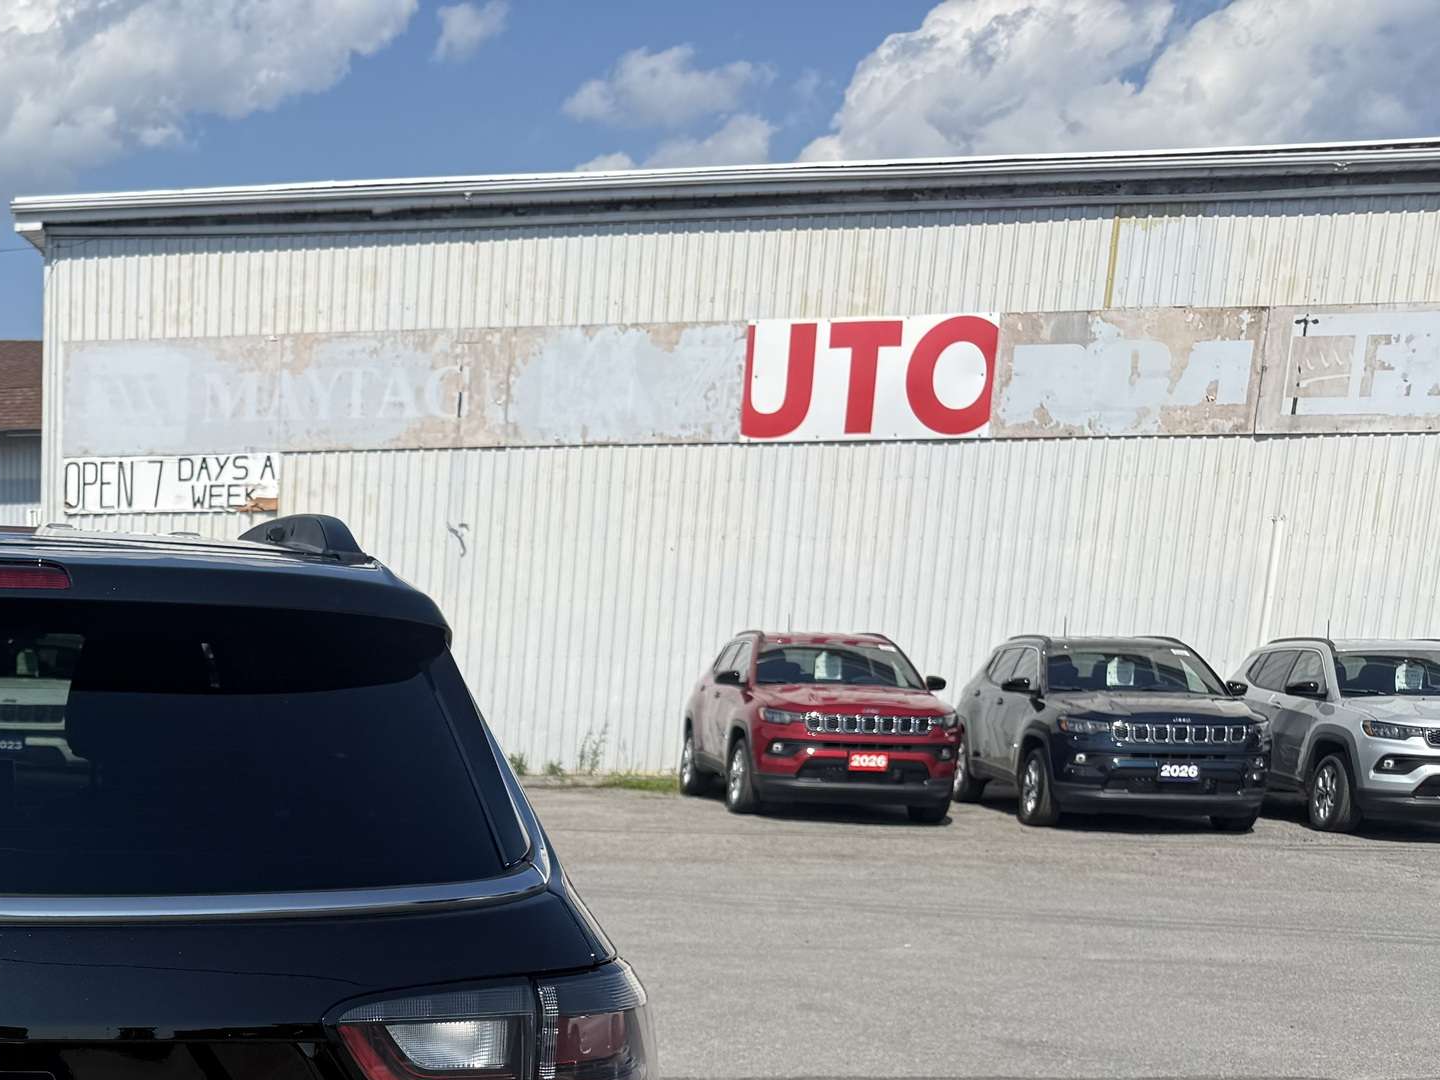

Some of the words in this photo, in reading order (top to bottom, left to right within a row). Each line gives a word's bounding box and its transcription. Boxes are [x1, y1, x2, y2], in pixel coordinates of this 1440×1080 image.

[740, 314, 1000, 438] UTO
[63, 460, 134, 509] OPEN
[147, 460, 164, 509] 7
[177, 456, 249, 483] DAYS
[259, 455, 276, 481] A
[191, 484, 258, 510] WEEK
[850, 754, 888, 768] 2026
[1160, 764, 1199, 778] 2026
